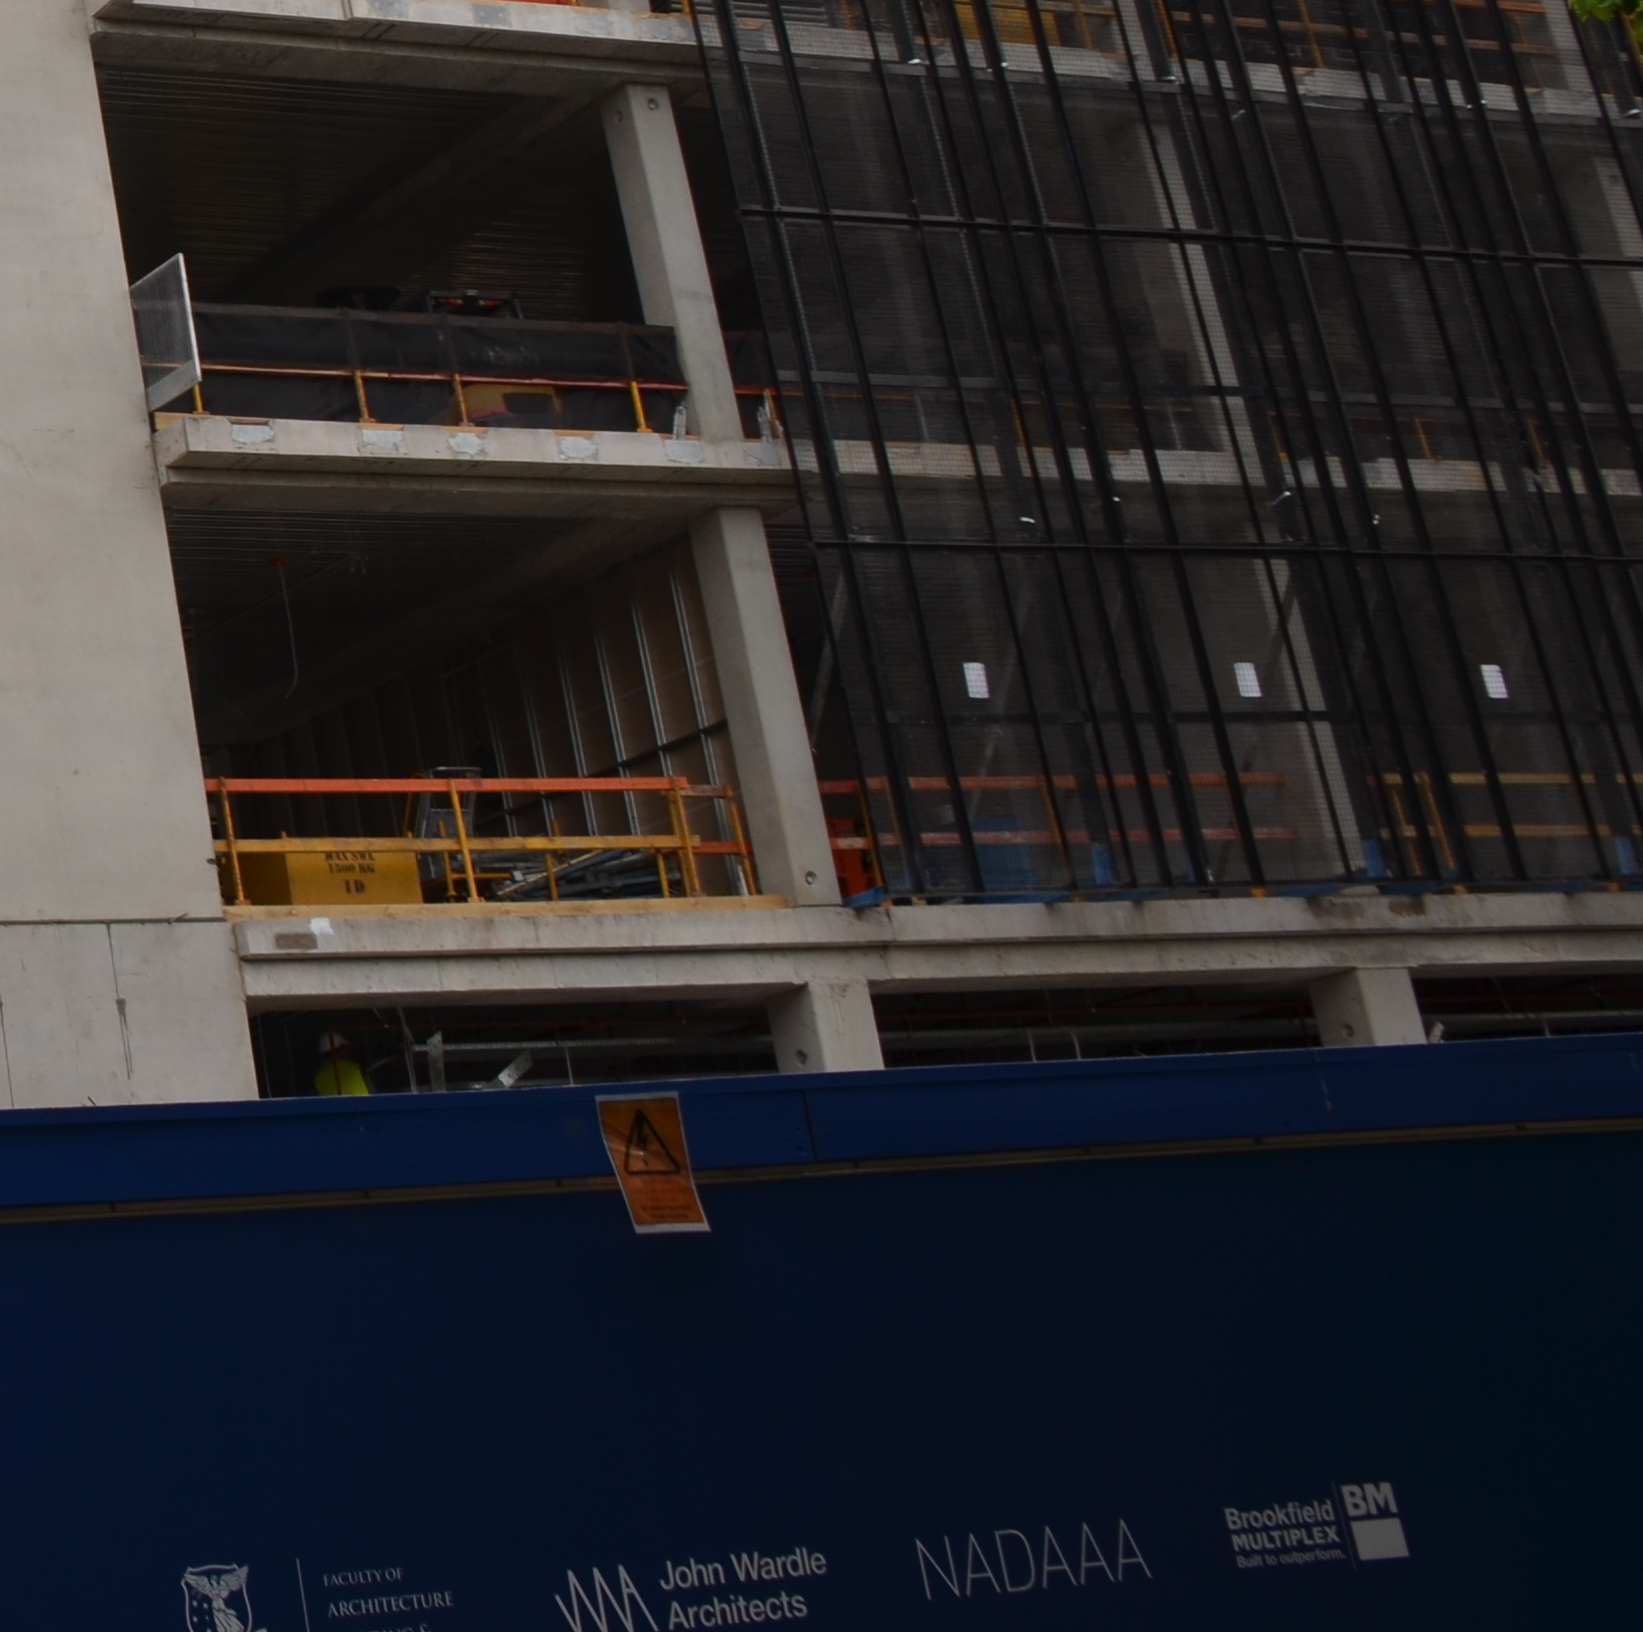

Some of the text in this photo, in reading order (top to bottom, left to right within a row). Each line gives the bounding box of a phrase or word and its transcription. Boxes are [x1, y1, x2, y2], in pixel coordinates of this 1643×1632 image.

[1223, 1499, 1336, 1530] Brookfield
[1340, 1481, 1399, 1517] BM
[1230, 1525, 1341, 1552] MULTIPLEX
[659, 1546, 828, 1591] John Wardle
[914, 1517, 1153, 1602] NADAAA
[1235, 1547, 1347, 1568] Built to outperform.
[322, 1567, 404, 1587] FACULTY OF
[327, 1590, 455, 1619] ARCHITECTURE
[668, 1590, 808, 1631] Architects
